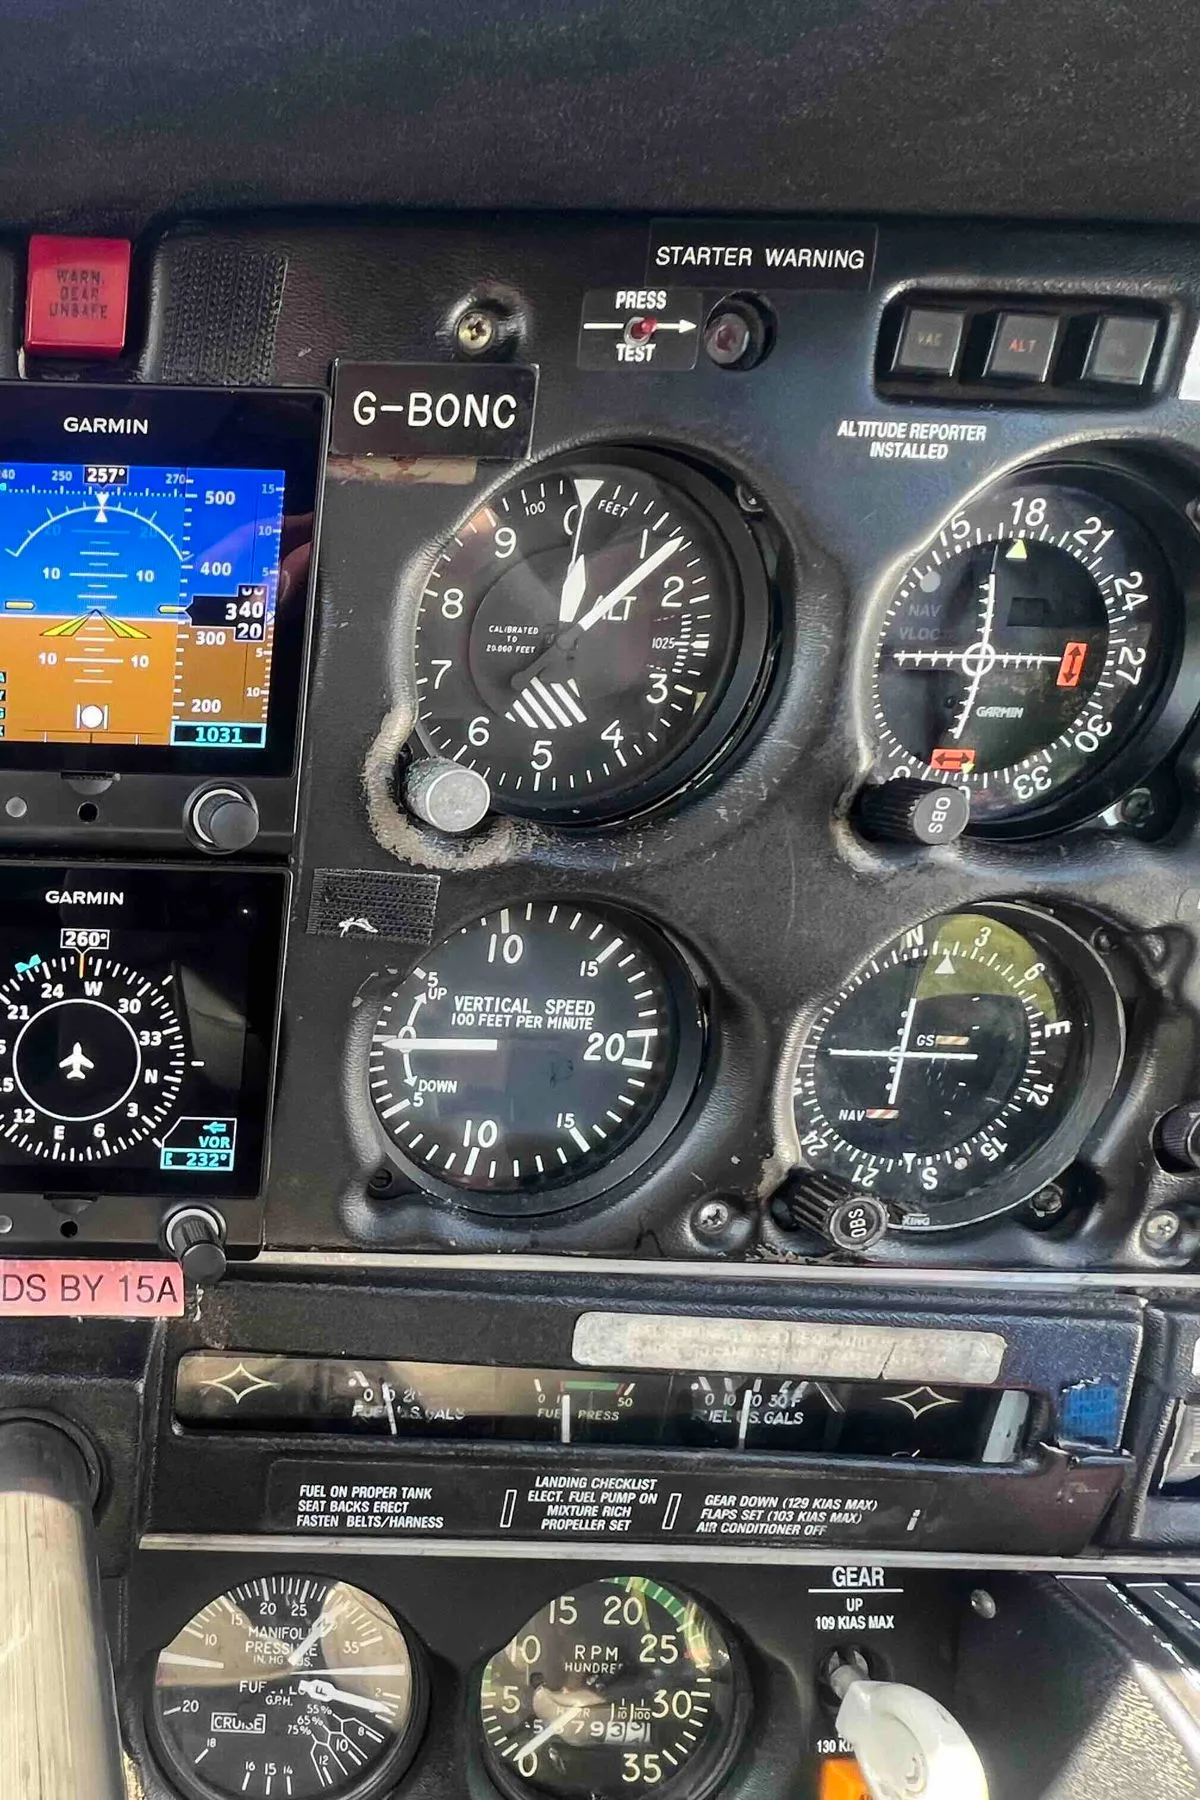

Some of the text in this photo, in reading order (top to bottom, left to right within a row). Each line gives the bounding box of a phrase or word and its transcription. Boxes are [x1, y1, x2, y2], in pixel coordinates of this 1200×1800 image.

[656, 246, 864, 268] STARTER WARNING
[615, 290, 667, 309] PRESS
[616, 343, 656, 362] TEST
[1009, 338, 1037, 352] ALT
[353, 391, 517, 429] G-BONC
[63, 416, 149, 434] GARMIN
[837, 421, 987, 441] ALTITUDE REPORTER
[870, 442, 948, 459] INSTALLED
[205, 491, 236, 506] 500
[598, 500, 629, 518] FEET
[1011, 497, 1046, 527] 18
[1074, 516, 1114, 546] 21
[200, 562, 231, 576] 400
[489, 625, 539, 634] CALIBRATED
[195, 632, 226, 645] 300
[652, 637, 675, 649] 1025
[191, 699, 221, 713] 200
[195, 727, 243, 743] 1031
[928, 796, 951, 834] OBS
[45, 890, 124, 905] GARMIN
[65, 931, 107, 947] 260°
[455, 996, 595, 1016] VERTICAL SPEED
[451, 1014, 593, 1030] 100 FEET PER MINUTE
[583, 1032, 625, 1062] 20
[916, 1034, 935, 1047] GS
[839, 1109, 865, 1122] NAV
[199, 1136, 229, 1148] VOR
[848, 1207, 867, 1238] OBS
[60, 1276, 104, 1302] BY
[118, 1276, 177, 1303] 15A
[535, 1476, 657, 1490] LANDING CHECKLIST
[300, 1485, 432, 1500] FUEL ON PROPER TANK
[528, 1491, 658, 1504] ELECT. FUEL PUMP ON
[547, 1505, 632, 1517] MIXTURE RICH
[705, 1495, 878, 1512] GEAR DOWN (129 KIAS MAX)
[297, 1515, 444, 1529] FASTEN BELTS/HARNESS
[701, 1508, 862, 1524] FLAPS SET (103 KIAS MAX)
[541, 1519, 632, 1531] PROPELLER SET
[696, 1522, 827, 1536] AIR CONDITIONER OFF
[832, 1567, 884, 1587] GEAR
[260, 1603, 276, 1616] 20
[291, 1604, 307, 1616] 25
[603, 1596, 643, 1625] 20
[847, 1598, 863, 1611] UP
[816, 1616, 894, 1629] 109 KIAS MAX
[575, 1645, 619, 1660] RPM
[652, 1690, 692, 1719] 30
